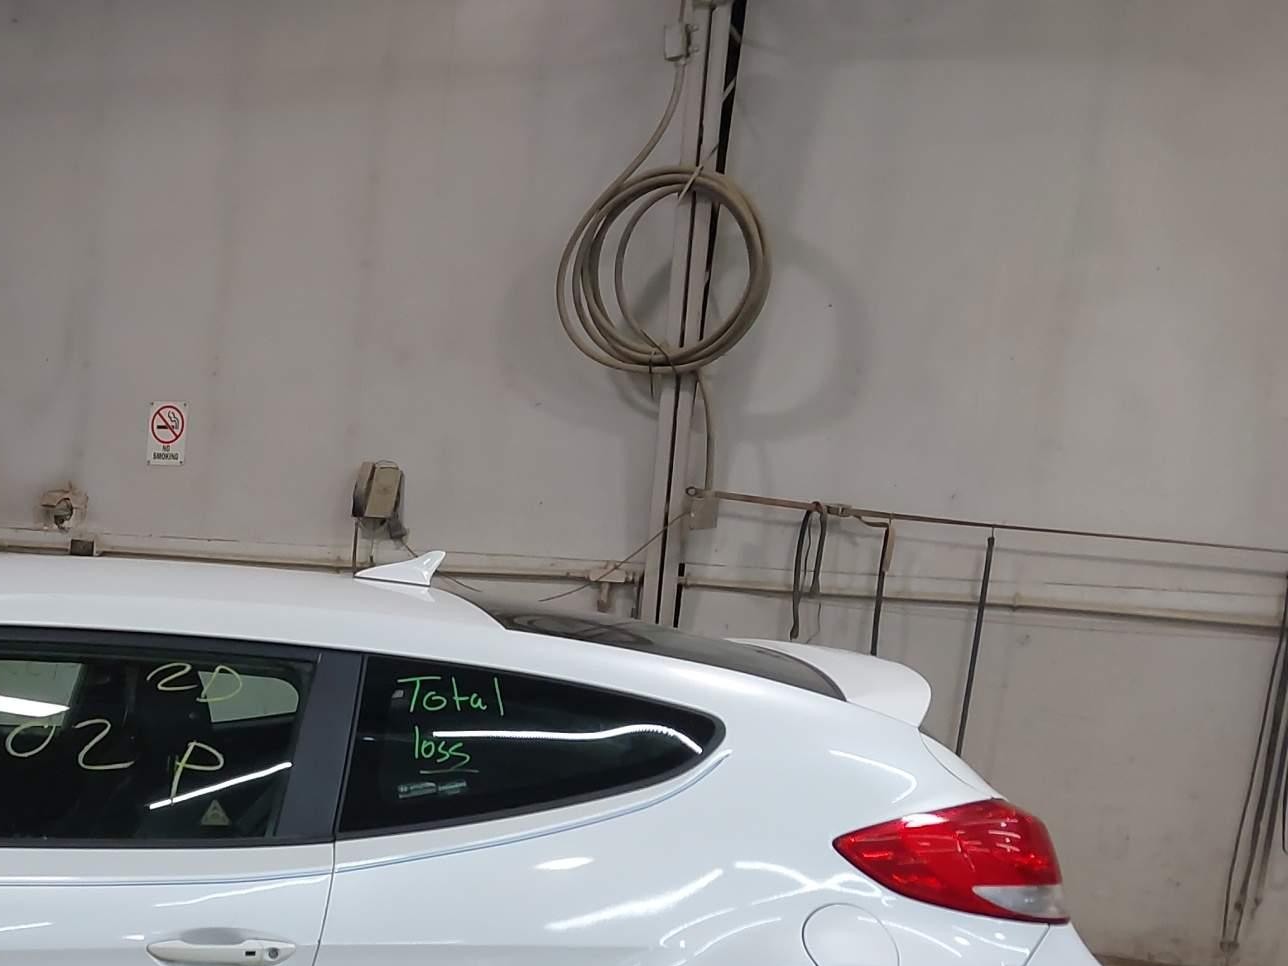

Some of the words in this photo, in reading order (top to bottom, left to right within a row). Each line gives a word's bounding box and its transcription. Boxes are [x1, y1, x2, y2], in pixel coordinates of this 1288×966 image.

[153, 452, 179, 461] SMOKING
[397, 676, 504, 716] Total
[414, 725, 471, 769] loss
[171, 740, 225, 806] P
